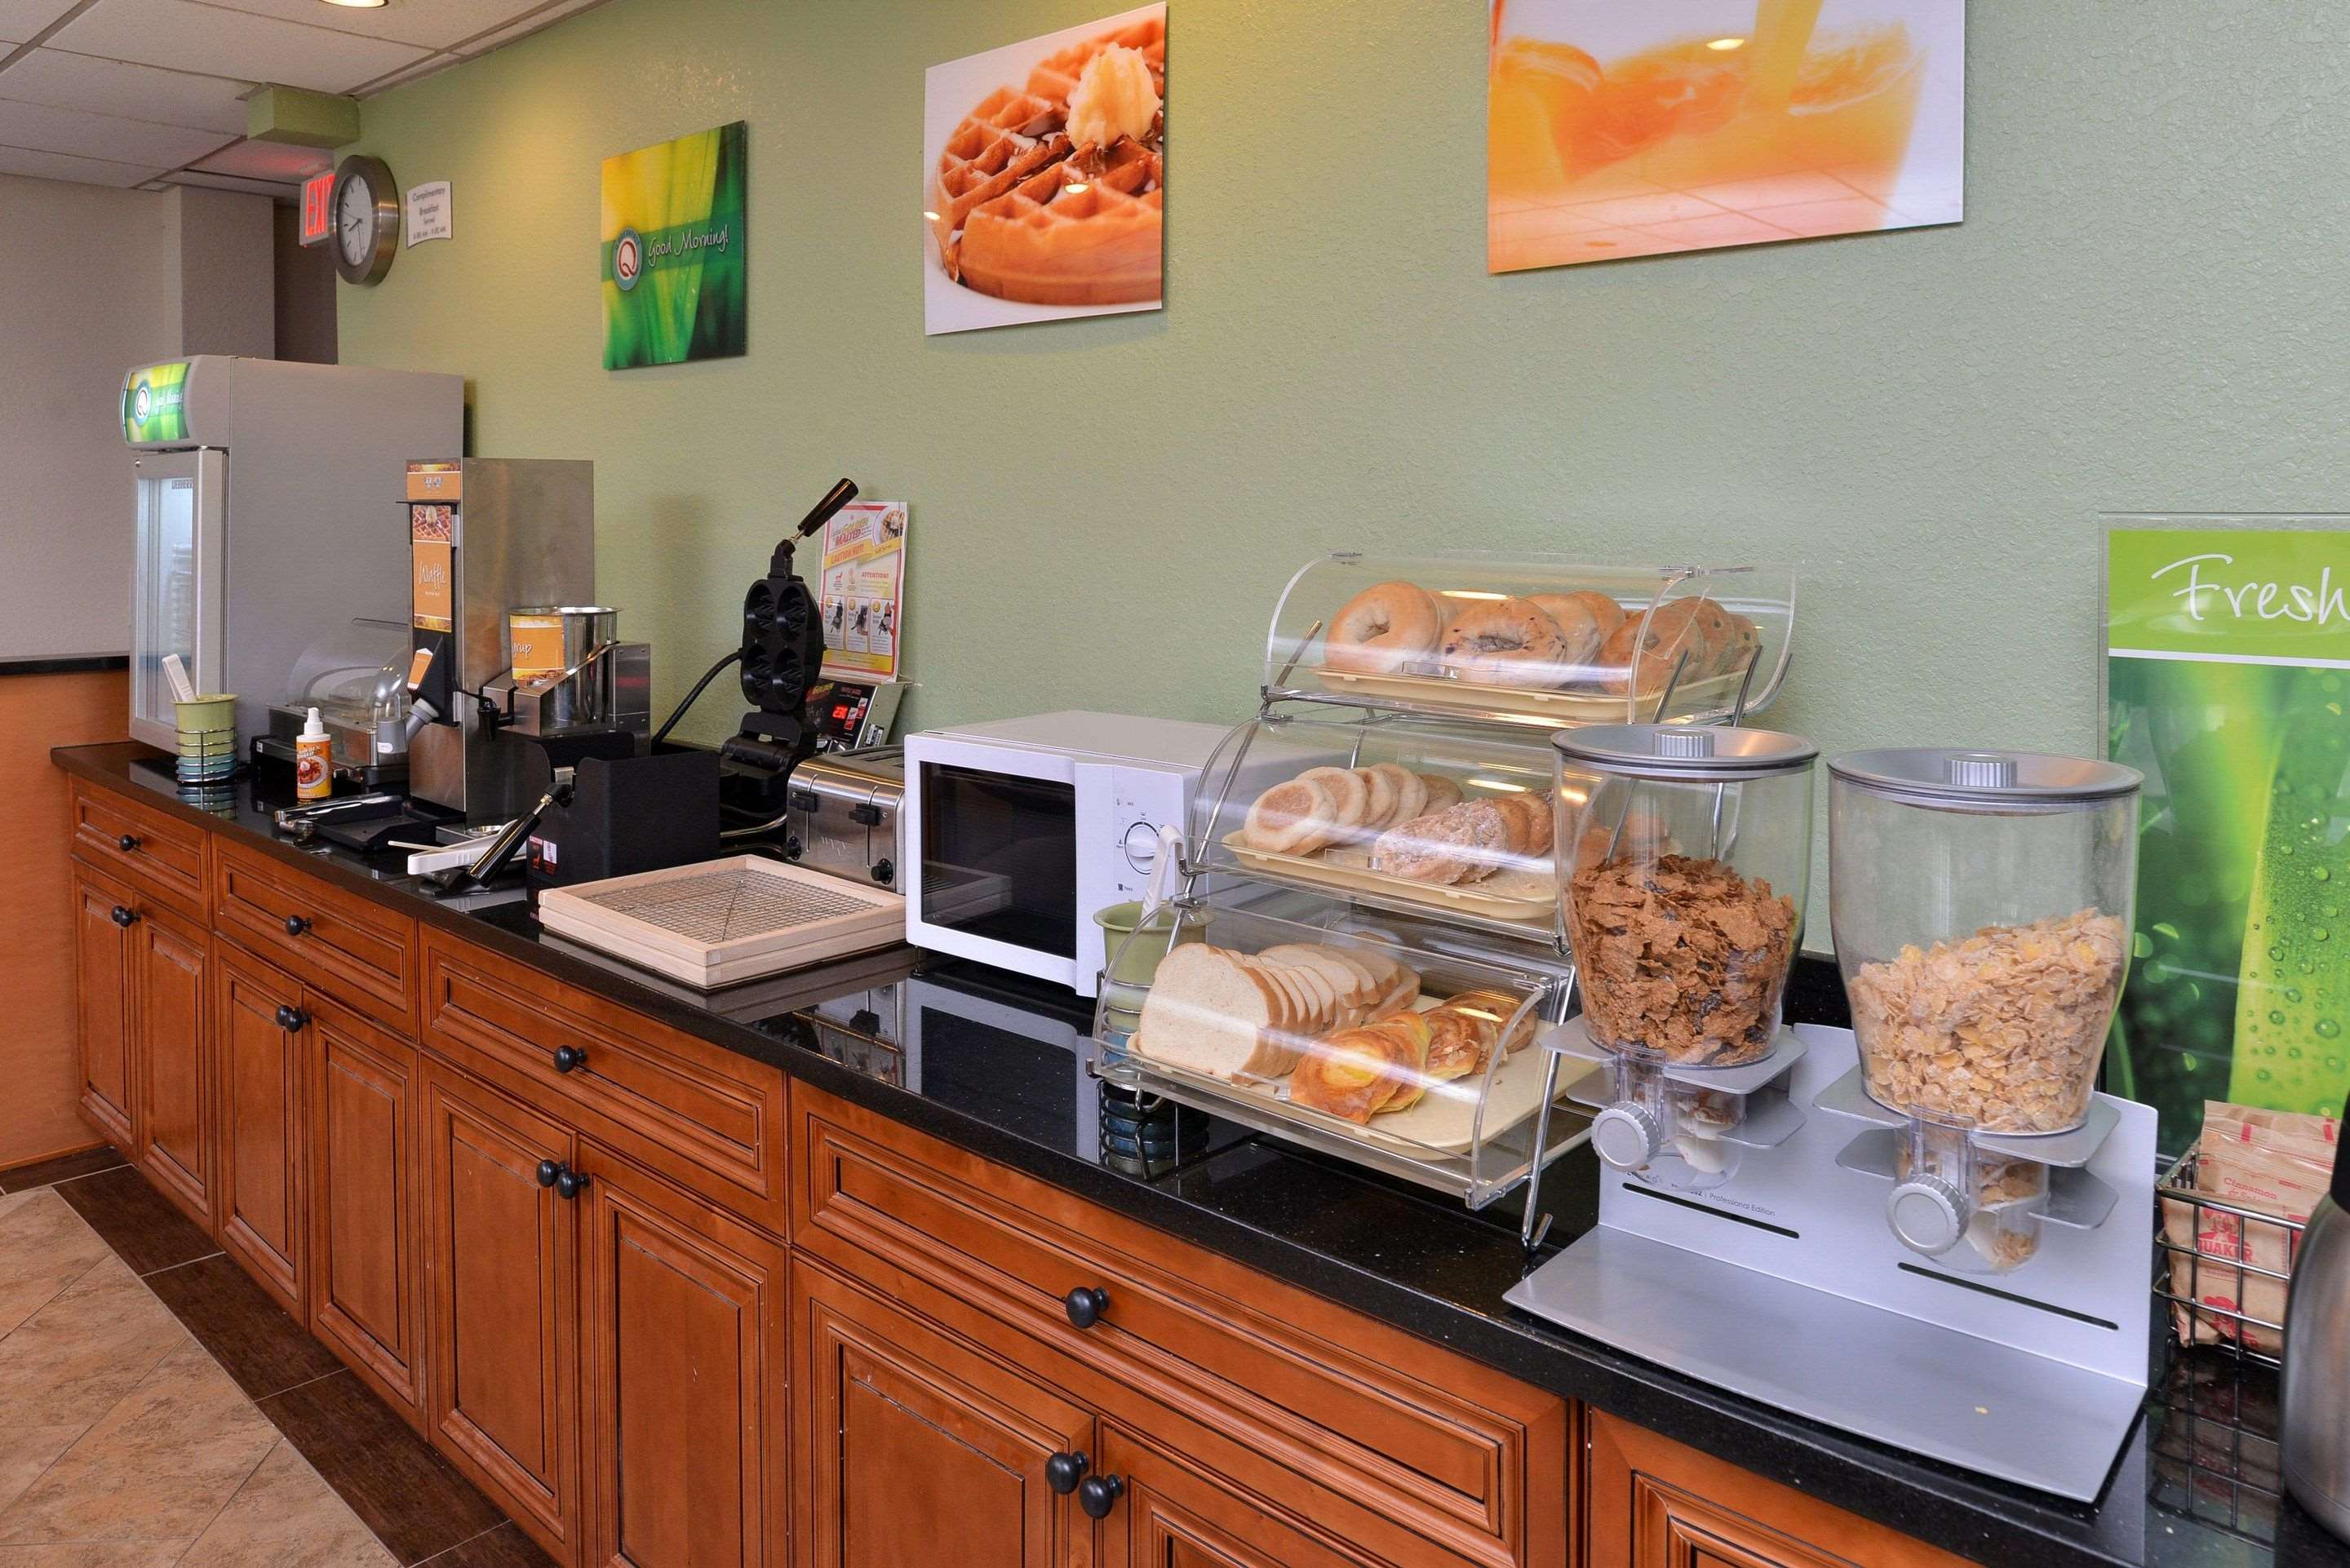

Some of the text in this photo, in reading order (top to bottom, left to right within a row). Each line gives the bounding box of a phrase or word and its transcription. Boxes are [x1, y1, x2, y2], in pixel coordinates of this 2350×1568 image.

[648, 235, 672, 268] Good
[674, 224, 729, 256] Morning!
[418, 560, 446, 590] Waffle
[2150, 553, 2350, 626] Fresh
[511, 641, 533, 660] yrup
[2224, 1176, 2278, 1200] Cinnamon
[1709, 1192, 1776, 1217] Professional Edition
